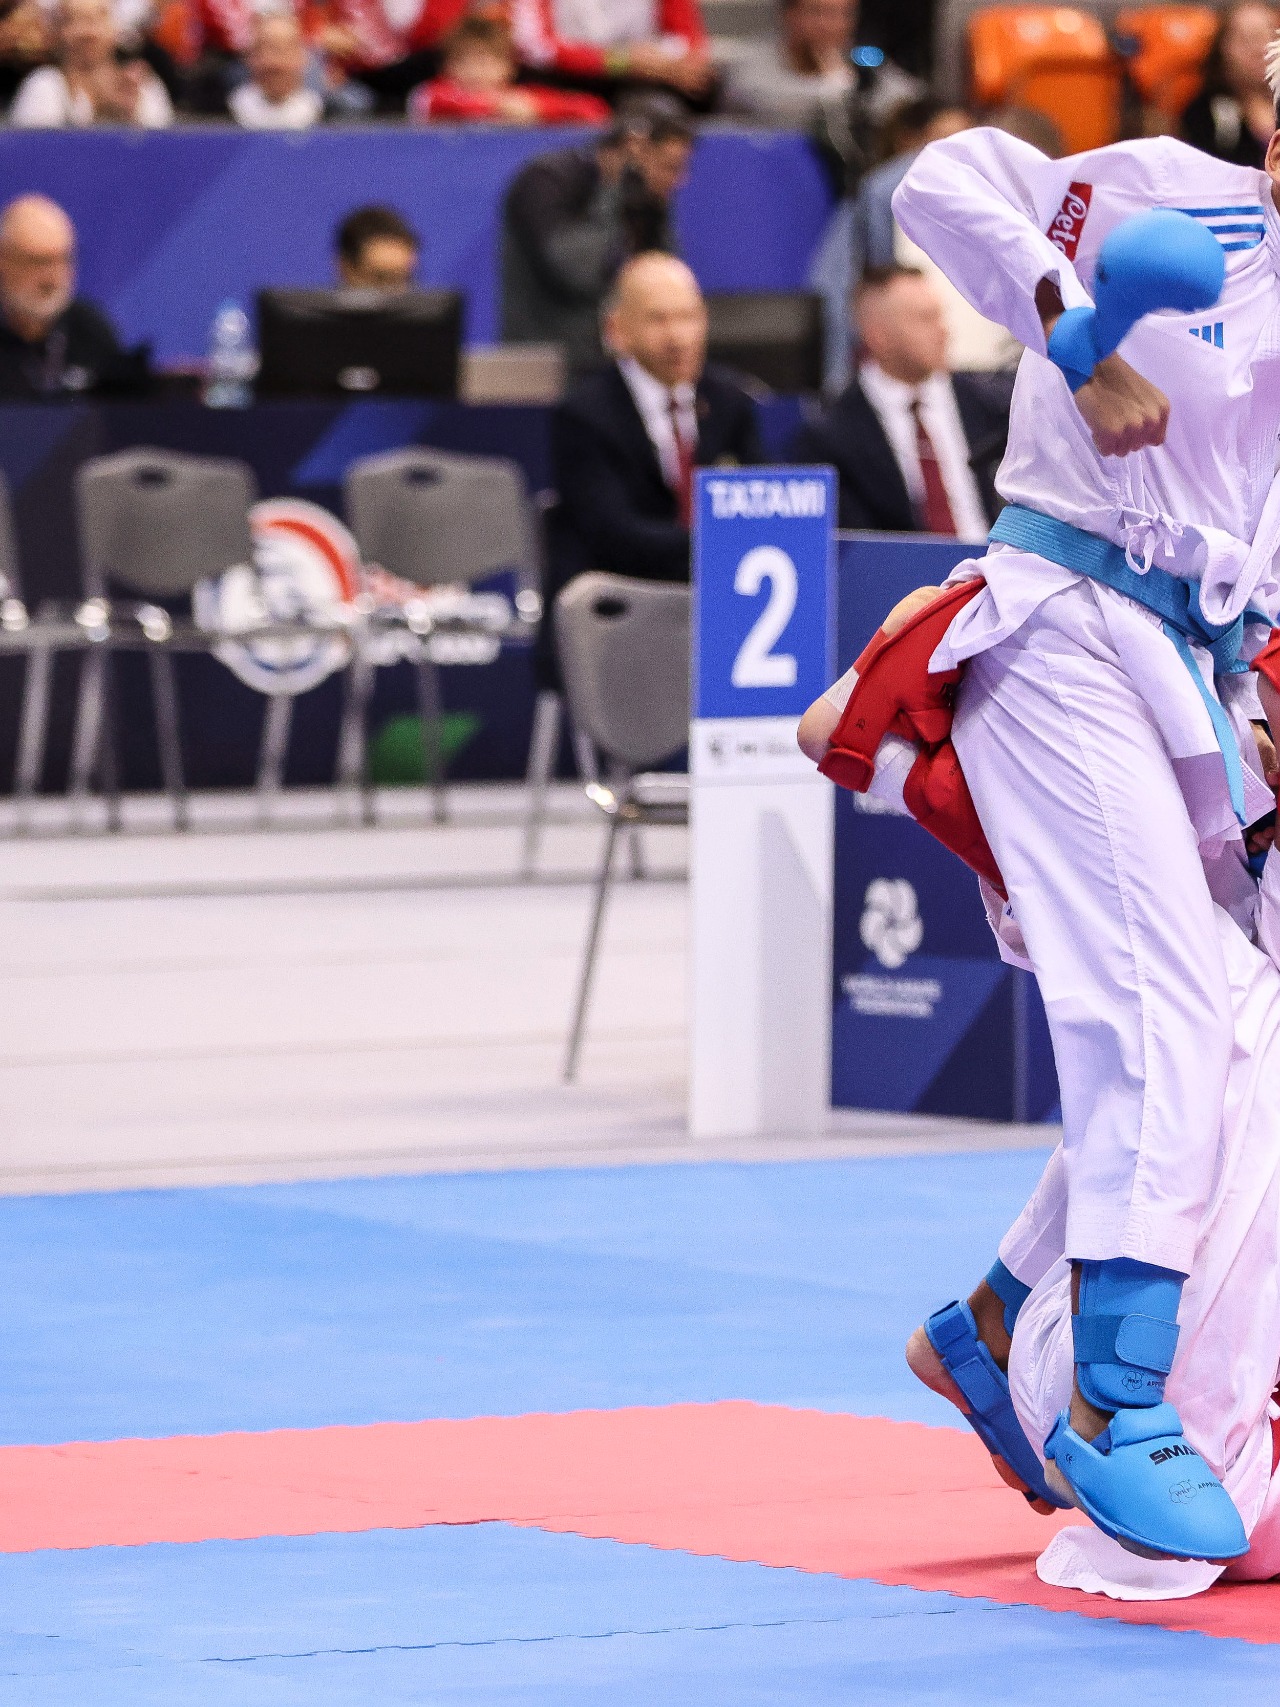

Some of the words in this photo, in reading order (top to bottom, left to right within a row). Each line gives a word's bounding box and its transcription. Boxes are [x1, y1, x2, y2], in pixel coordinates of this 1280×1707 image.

[706, 480, 826, 519] TATAMI
[731, 545, 798, 689] 2
[1149, 1444, 1199, 1466] SMA
